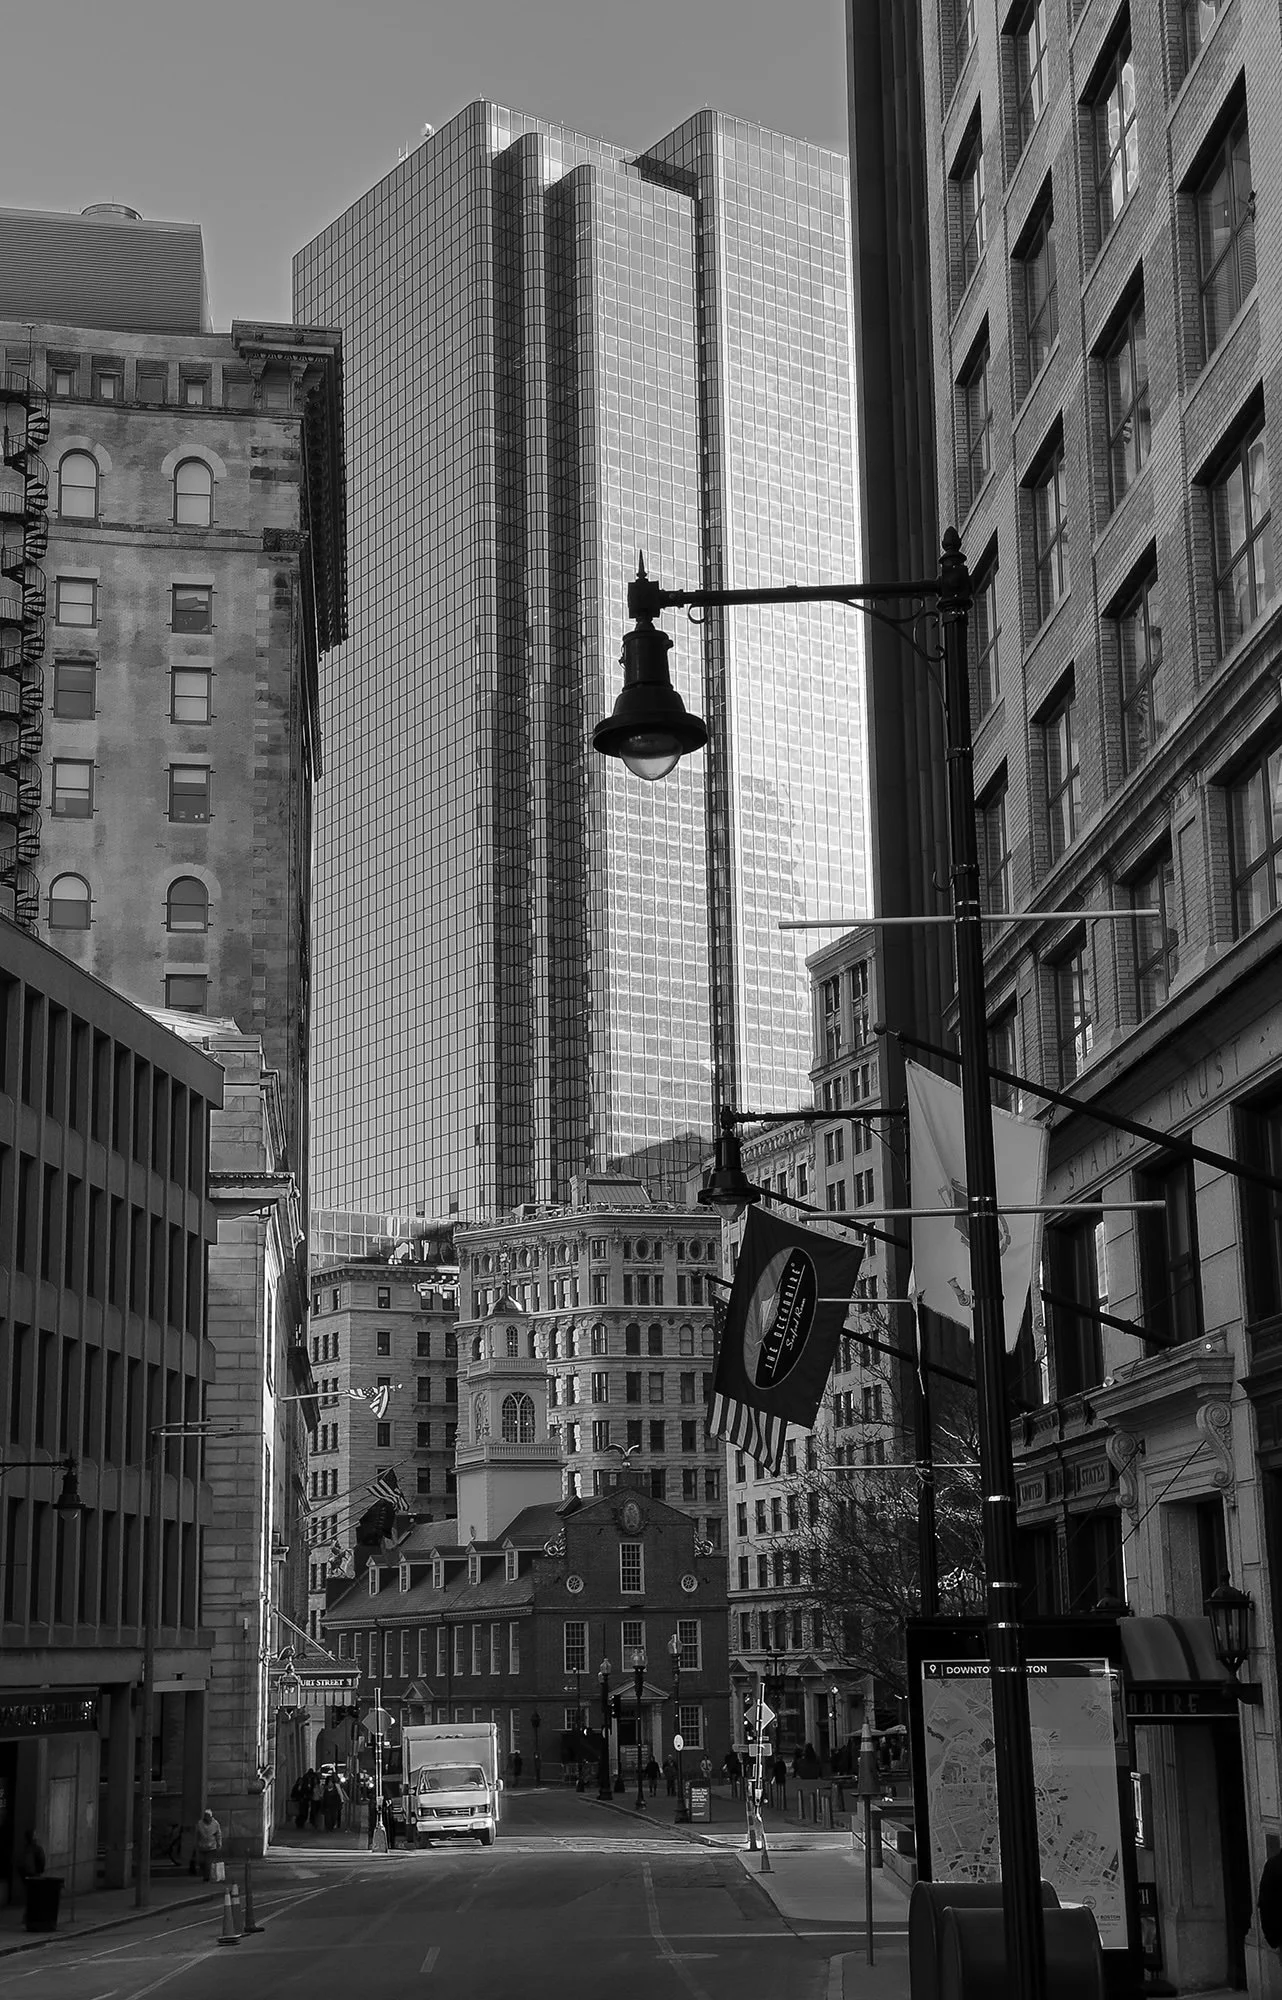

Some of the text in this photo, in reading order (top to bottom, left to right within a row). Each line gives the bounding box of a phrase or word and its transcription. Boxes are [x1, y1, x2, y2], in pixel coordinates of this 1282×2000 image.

[1164, 1035, 1241, 1121] TRUST
[765, 1346, 778, 1369] THE
[1081, 1463, 1105, 1487] STATES
[946, 1665, 992, 1675] DOWNTO
[316, 1678, 344, 1686] STREET
